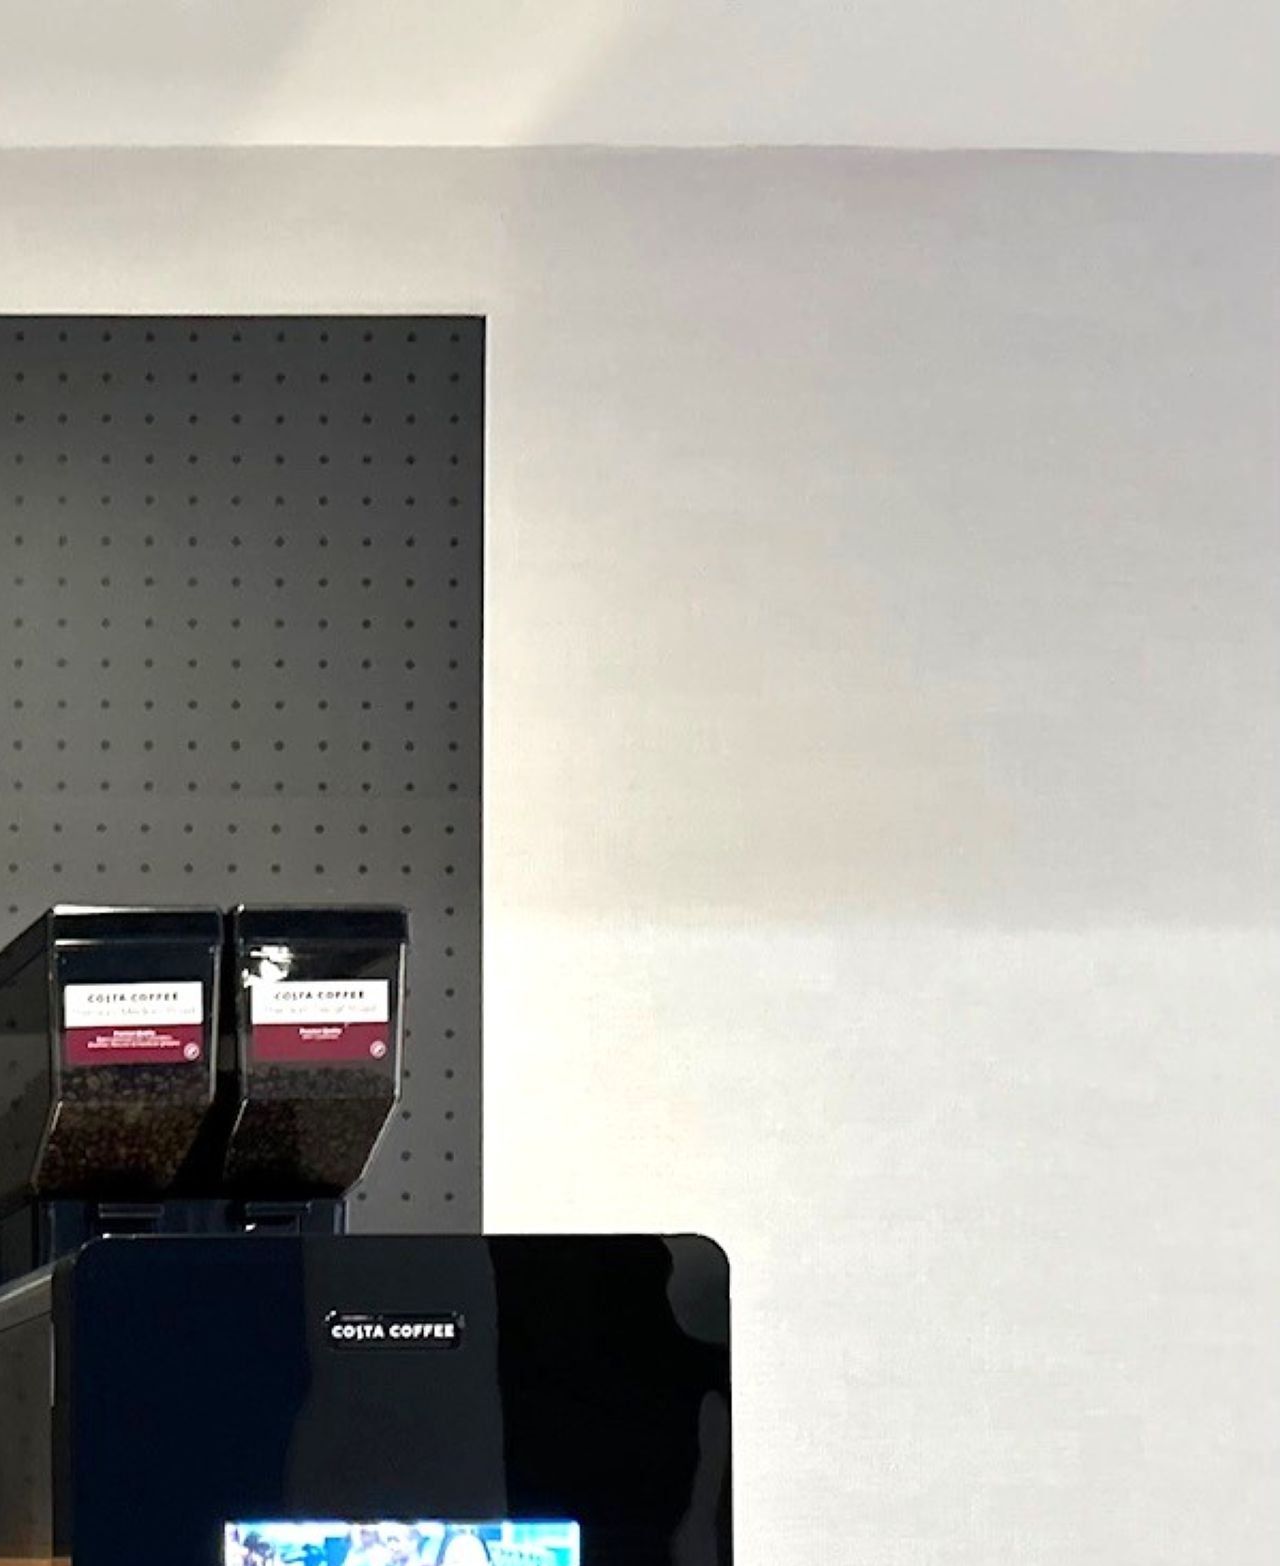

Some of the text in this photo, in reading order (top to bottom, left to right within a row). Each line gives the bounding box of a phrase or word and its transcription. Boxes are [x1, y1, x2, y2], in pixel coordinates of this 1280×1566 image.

[87, 991, 179, 1004] COSTA COFFEE
[274, 990, 365, 1001] COSTA COFFEE
[331, 1323, 455, 1340] COSTA COFFEE
